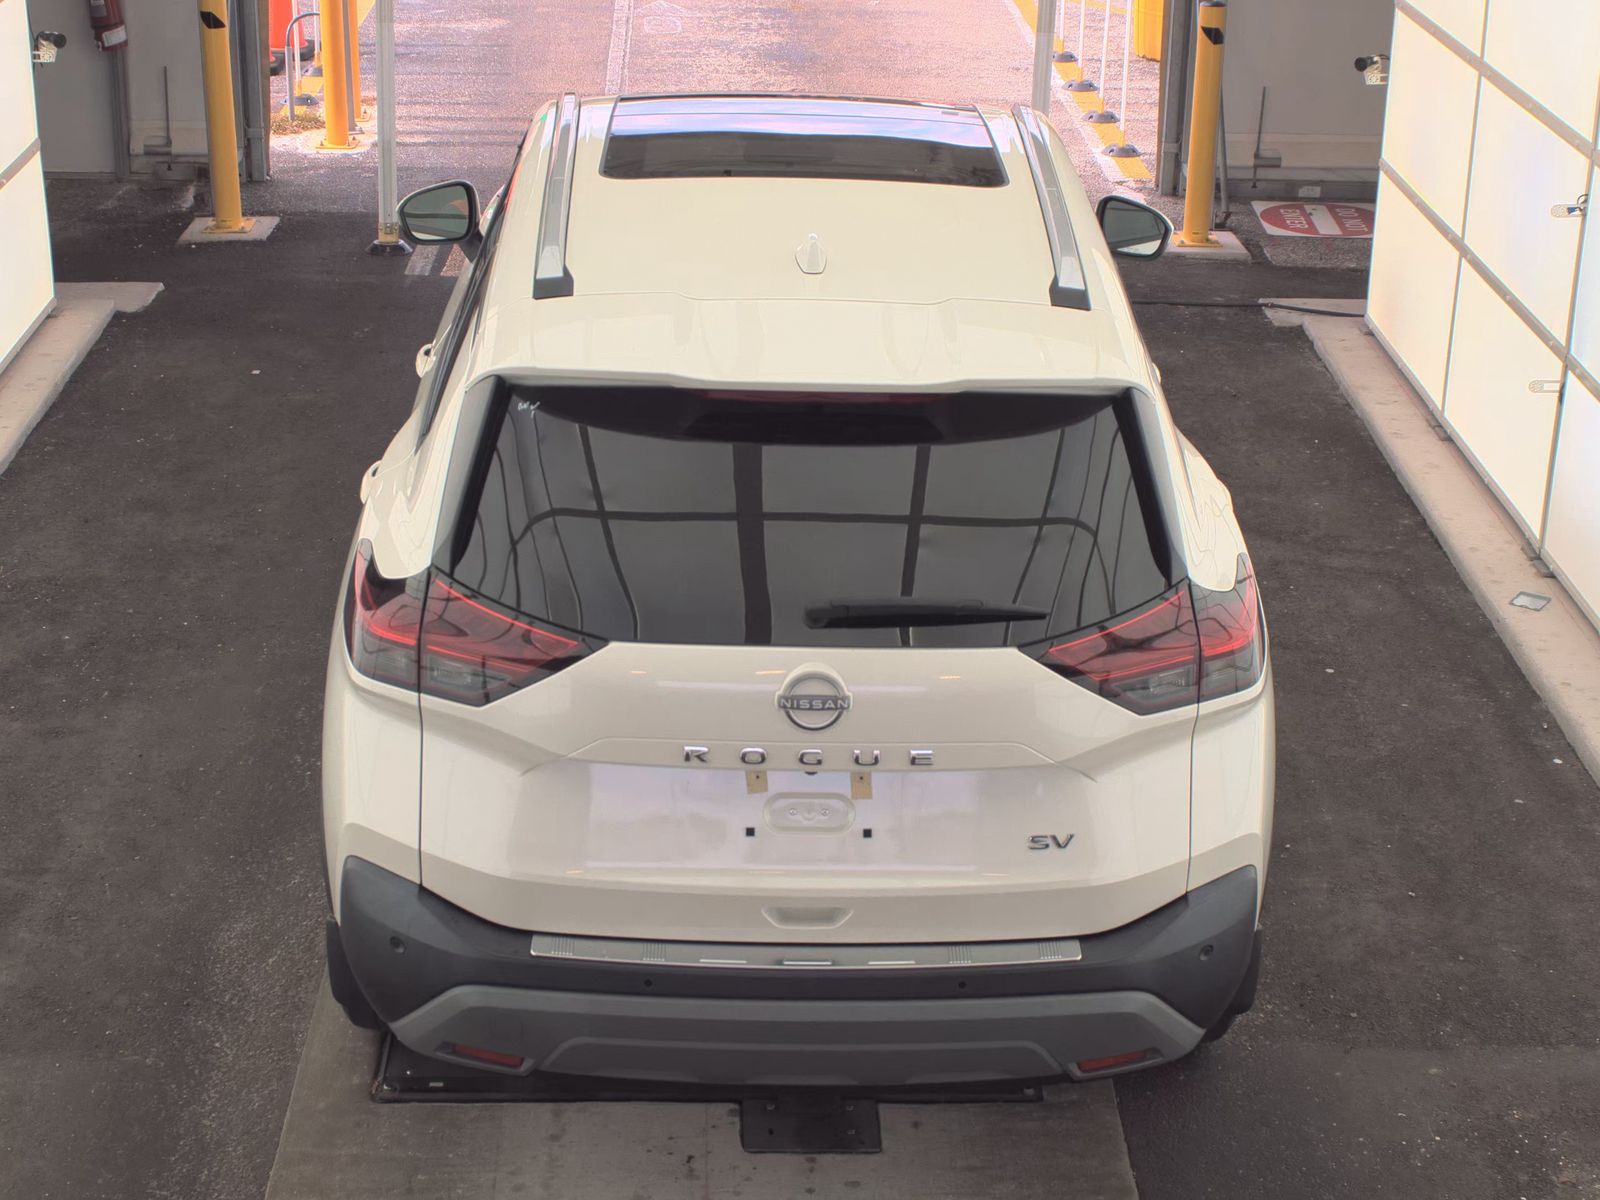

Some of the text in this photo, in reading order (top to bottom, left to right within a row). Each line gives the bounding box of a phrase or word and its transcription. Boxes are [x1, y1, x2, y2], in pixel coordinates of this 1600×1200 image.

[1280, 208, 1309, 229] ENTER
[1335, 208, 1369, 232] DO NOT
[779, 698, 849, 709] NISSAN
[683, 745, 935, 767] ROGUE
[1028, 834, 1075, 850] SV
